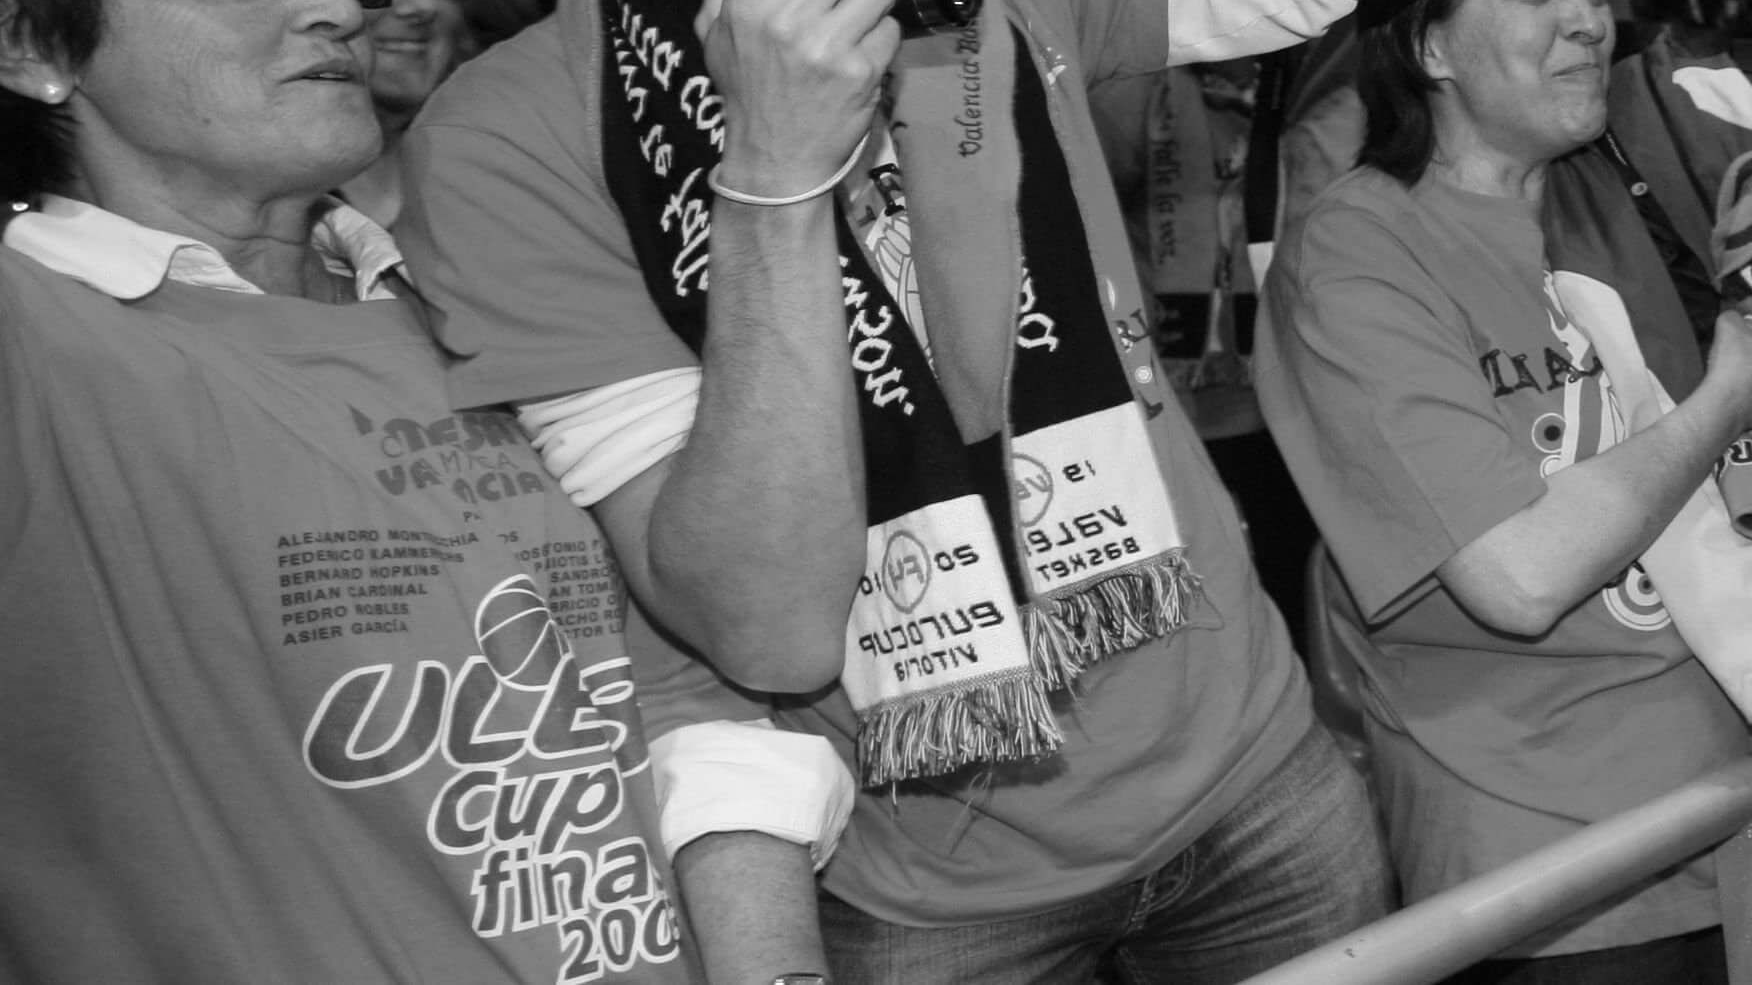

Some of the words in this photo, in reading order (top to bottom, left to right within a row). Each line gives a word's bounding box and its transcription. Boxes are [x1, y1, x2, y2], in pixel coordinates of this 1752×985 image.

[953, 61, 984, 158] Valencia
[277, 529, 379, 549] ALEJANDRO
[278, 549, 364, 568] FEDERICO
[280, 567, 363, 588] BERNARD
[369, 564, 440, 579] HOPKINS
[281, 586, 341, 607] BRIAN
[348, 583, 428, 598] CARDINAL
[549, 587, 571, 598] AN
[577, 582, 609, 595] TOM
[282, 605, 348, 627] PEDRO
[354, 603, 409, 615] ROBLES
[283, 625, 343, 646] ASIER
[470, 837, 664, 939] fina
[556, 899, 681, 985] 200
